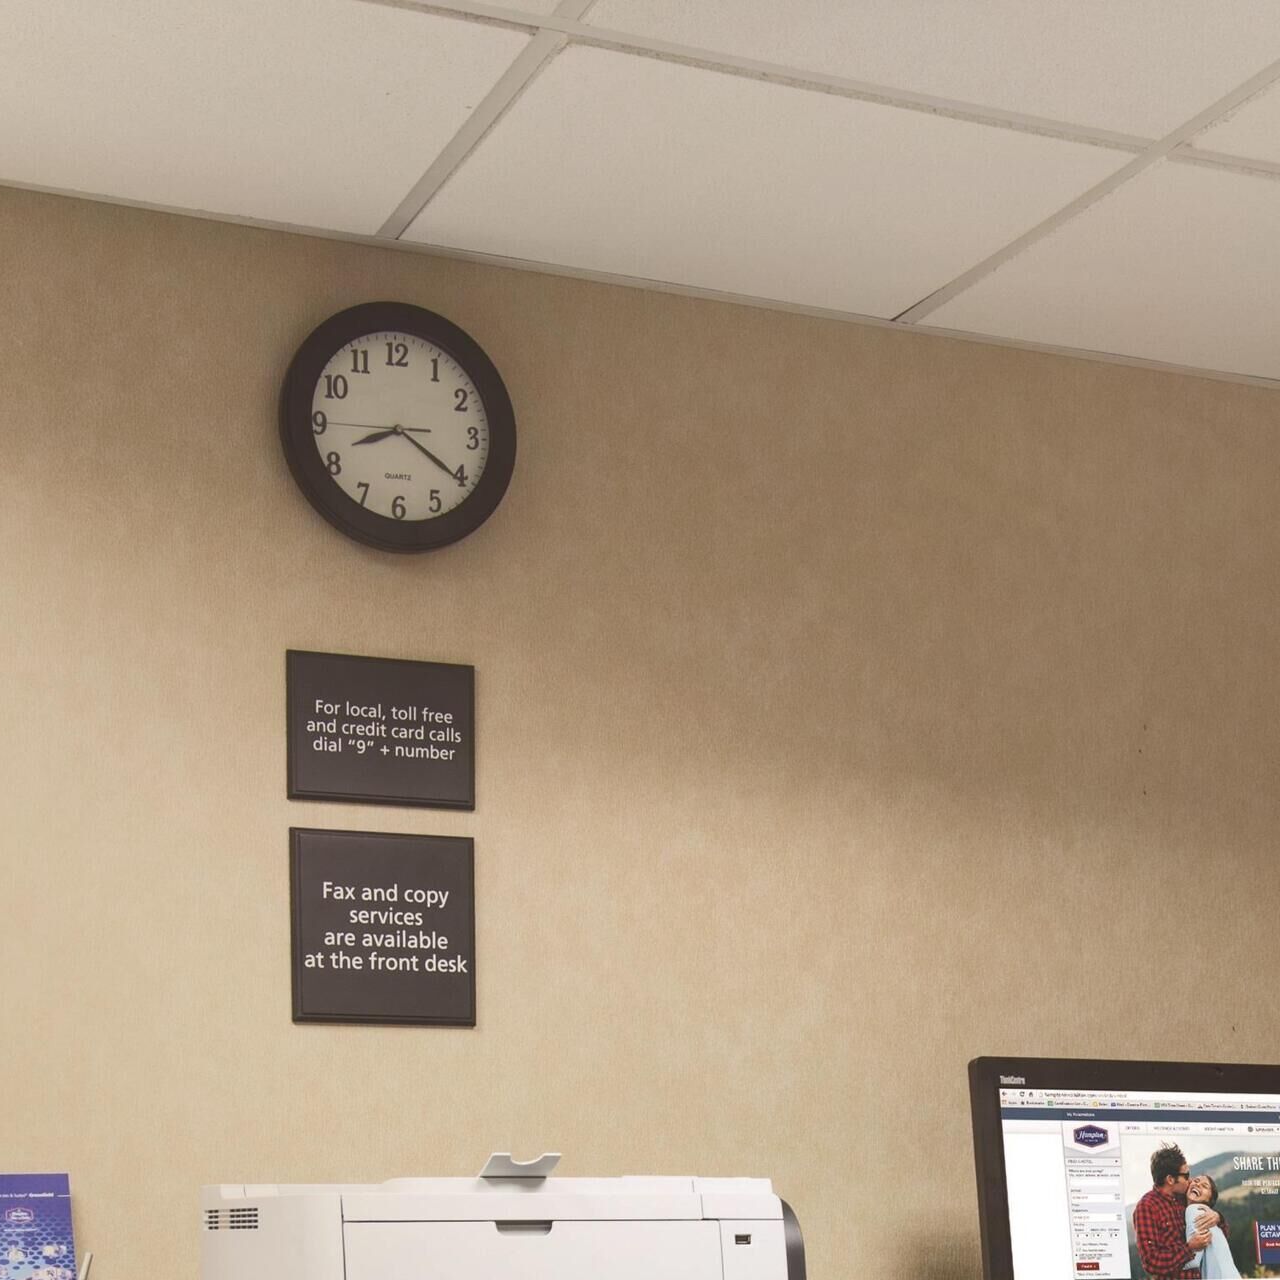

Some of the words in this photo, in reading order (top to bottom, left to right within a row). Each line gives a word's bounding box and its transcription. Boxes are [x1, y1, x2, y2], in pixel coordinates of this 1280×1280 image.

[351, 349, 370, 374] 11
[385, 342, 409, 367] 12
[431, 358, 440, 382] 1
[325, 374, 348, 399] 10
[454, 389, 468, 411] 2
[313, 411, 327, 435] 9
[466, 427, 479, 450] 3
[327, 452, 341, 475] 8
[384, 472, 412, 481] QUARTZ
[454, 464, 468, 487] 4
[357, 482, 369, 507] 7
[429, 490, 441, 513] 5
[392, 496, 406, 519] 6
[315, 700, 340, 715] For
[346, 701, 386, 721] local,
[391, 706, 416, 721] toll
[422, 707, 452, 723] free
[307, 719, 336, 733] and
[342, 722, 387, 737] credit
[391, 726, 424, 739] card
[429, 728, 461, 743] calls
[313, 736, 341, 752] dial
[380, 745, 390, 755] +
[395, 744, 455, 760] number
[323, 882, 355, 900] Fax
[362, 884, 397, 901] and
[404, 889, 449, 908] copy
[350, 907, 423, 925] services
[324, 932, 356, 946] are
[362, 930, 448, 949] available
[305, 952, 324, 968] at
[330, 951, 363, 969] the
[369, 952, 419, 971] front
[425, 954, 467, 973] desk
[1233, 1156, 1264, 1171] SHARE
